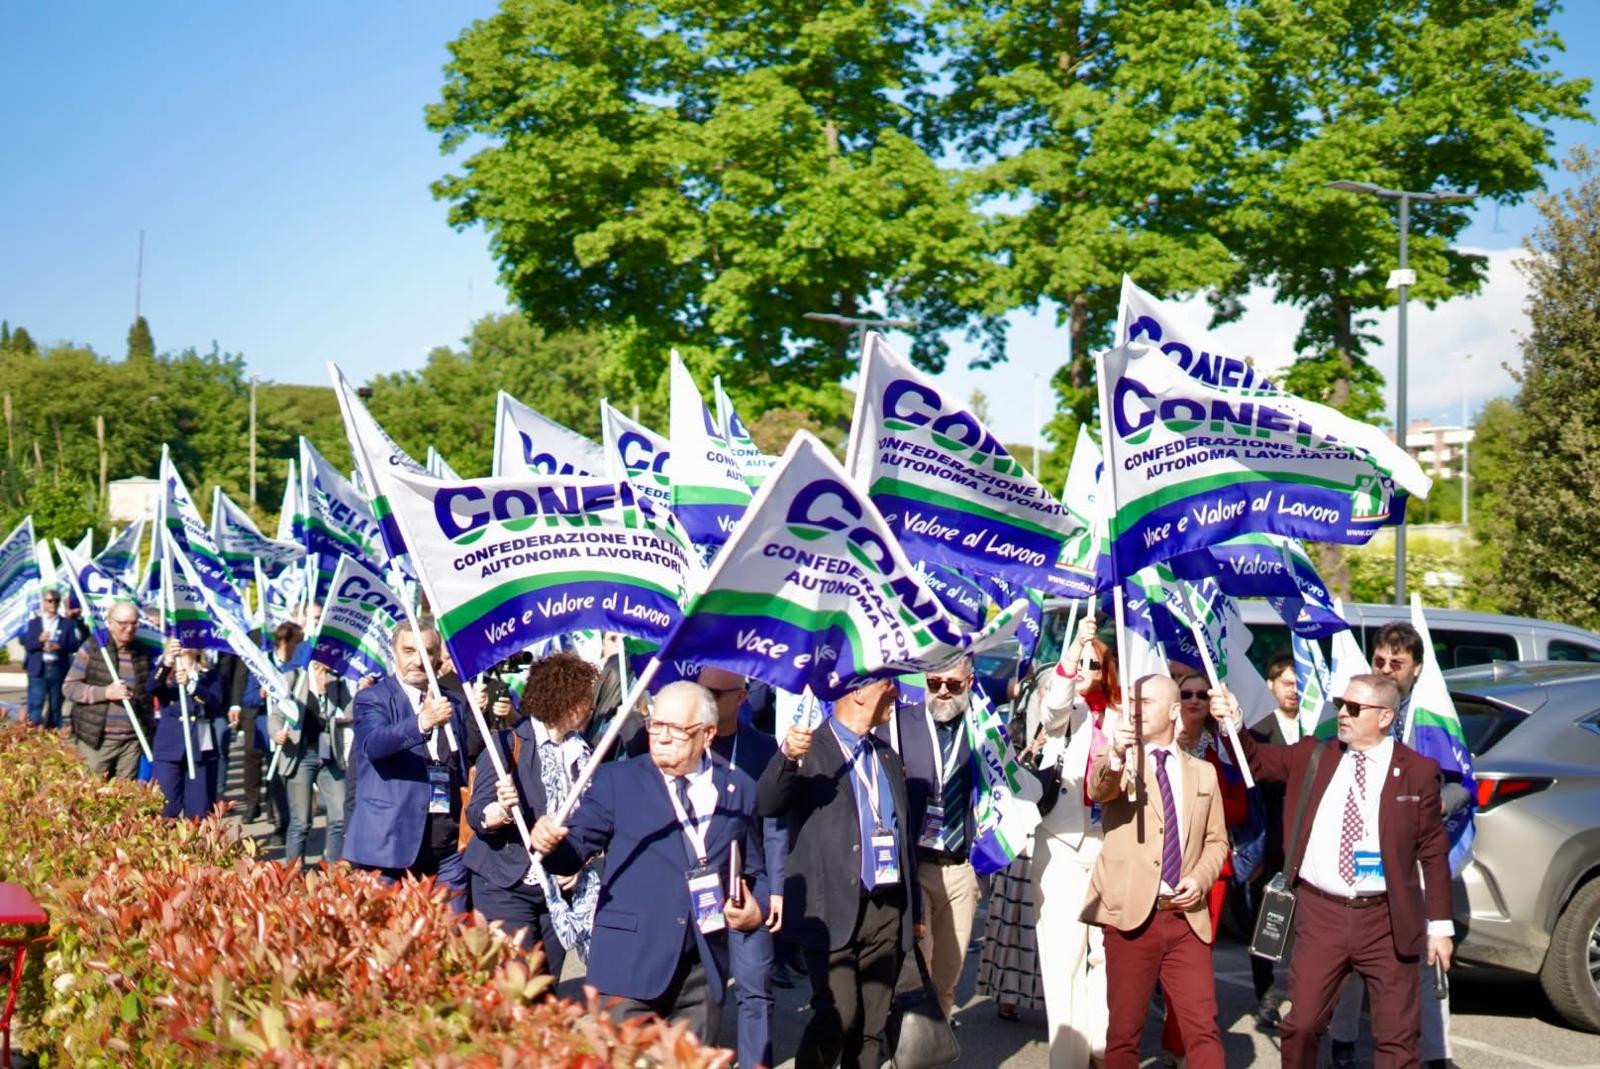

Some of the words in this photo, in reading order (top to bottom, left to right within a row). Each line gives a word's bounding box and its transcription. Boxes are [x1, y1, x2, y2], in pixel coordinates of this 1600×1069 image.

[880, 453, 978, 490] AUTONOMA
[1124, 437, 1294, 470] CONFEDERAZIONE
[1146, 449, 1239, 480] AUTONOMA
[904, 510, 960, 541] Valore
[962, 528, 988, 547] al
[984, 533, 1046, 567] Lavoro
[1143, 523, 1171, 549] Voce
[1177, 516, 1188, 532] e
[1192, 499, 1246, 526] Valore
[1251, 490, 1273, 511] al
[1277, 493, 1340, 524] Lavoro
[453, 532, 627, 572] CONFEDERAZIONE
[481, 547, 581, 579] AUTONOMA
[586, 546, 682, 575] LAVORATORI
[1229, 553, 1283, 576] Valore
[484, 616, 516, 644] Voce
[521, 609, 533, 624] e
[537, 592, 595, 618] Valore
[602, 591, 618, 611] al
[623, 595, 671, 627] Lavoro
[784, 570, 880, 629] AUTONOMA
[736, 628, 789, 659] Voce
[793, 653, 812, 669] e
